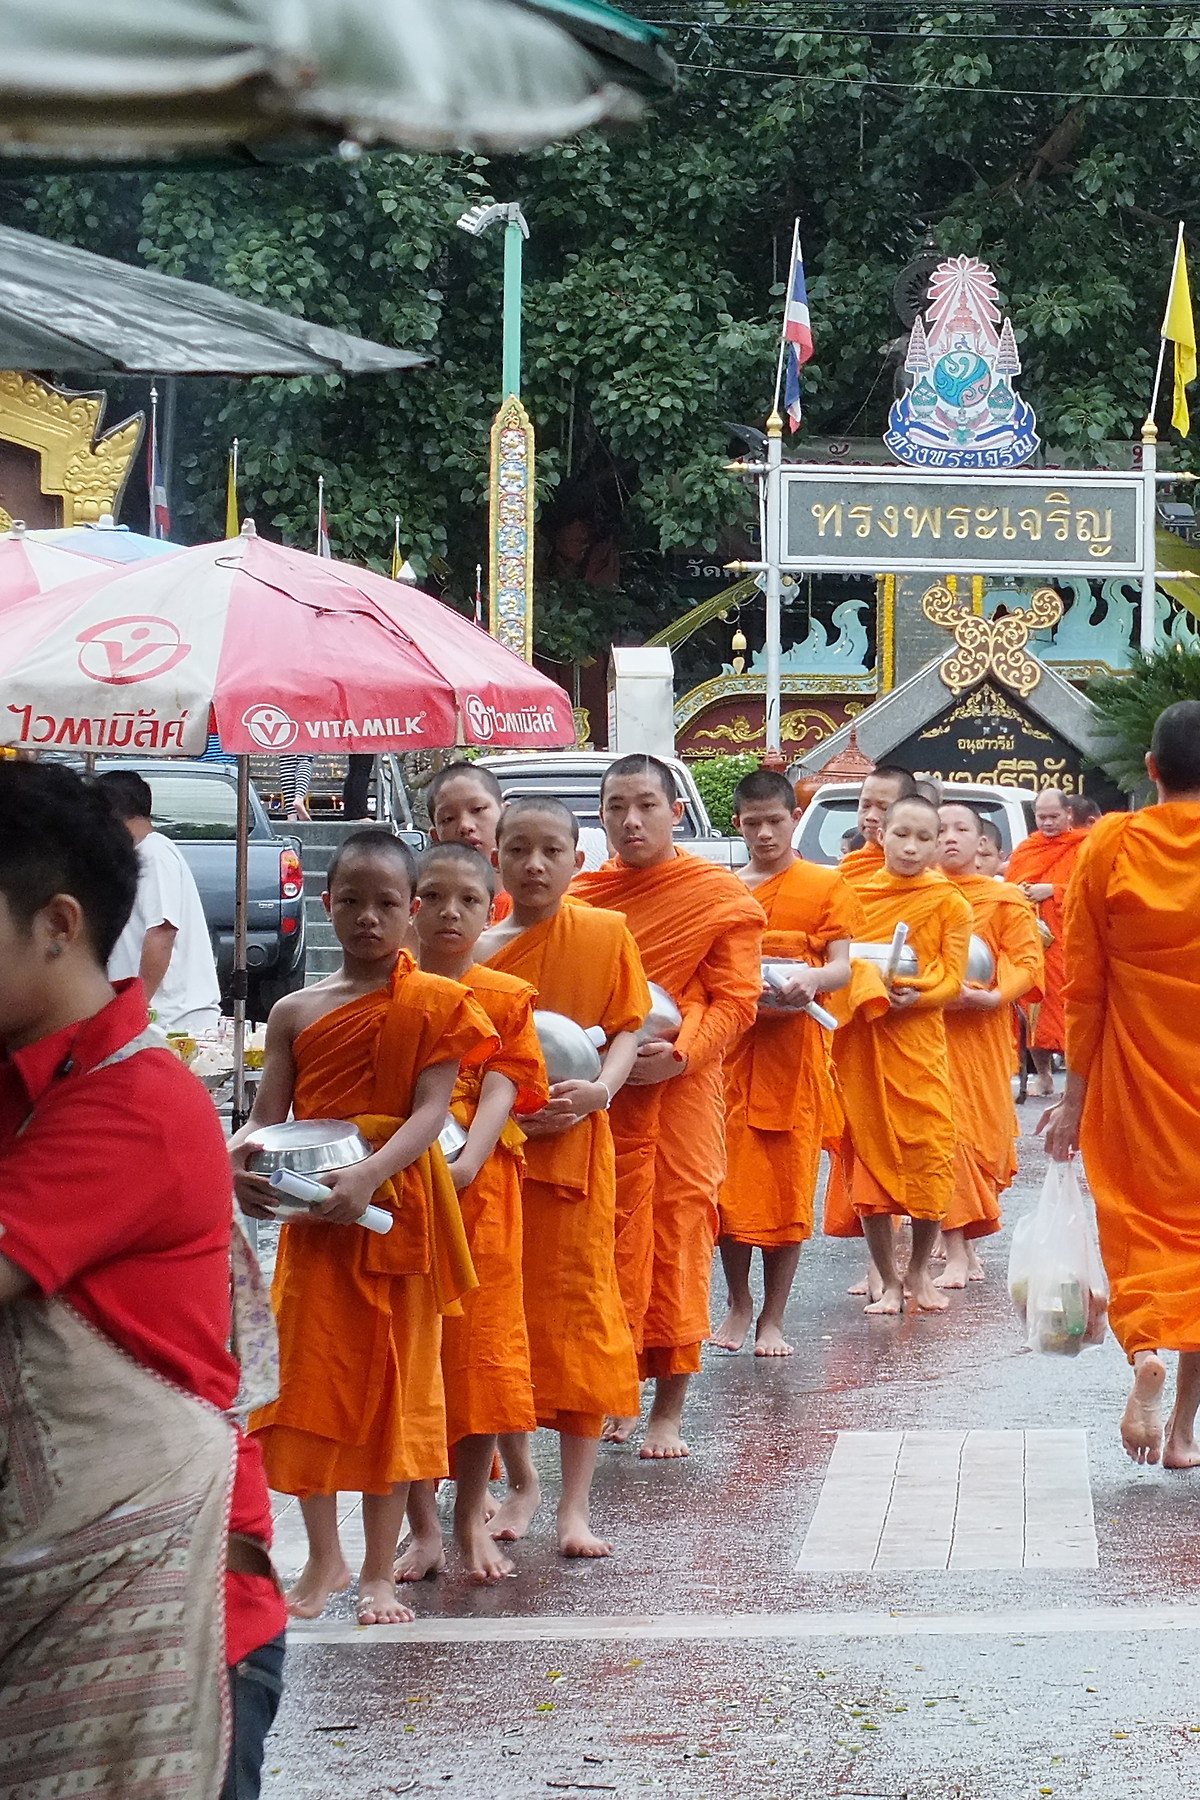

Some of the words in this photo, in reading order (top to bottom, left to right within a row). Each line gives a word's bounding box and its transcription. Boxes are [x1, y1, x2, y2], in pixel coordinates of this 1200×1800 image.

[887, 431, 1035, 468] ทรงพระเจริญ
[811, 491, 1113, 557] ทรงพระเจริญ
[304, 716, 425, 739] VITAMILK
[957, 734, 1015, 755] อนุสาวรีย์
